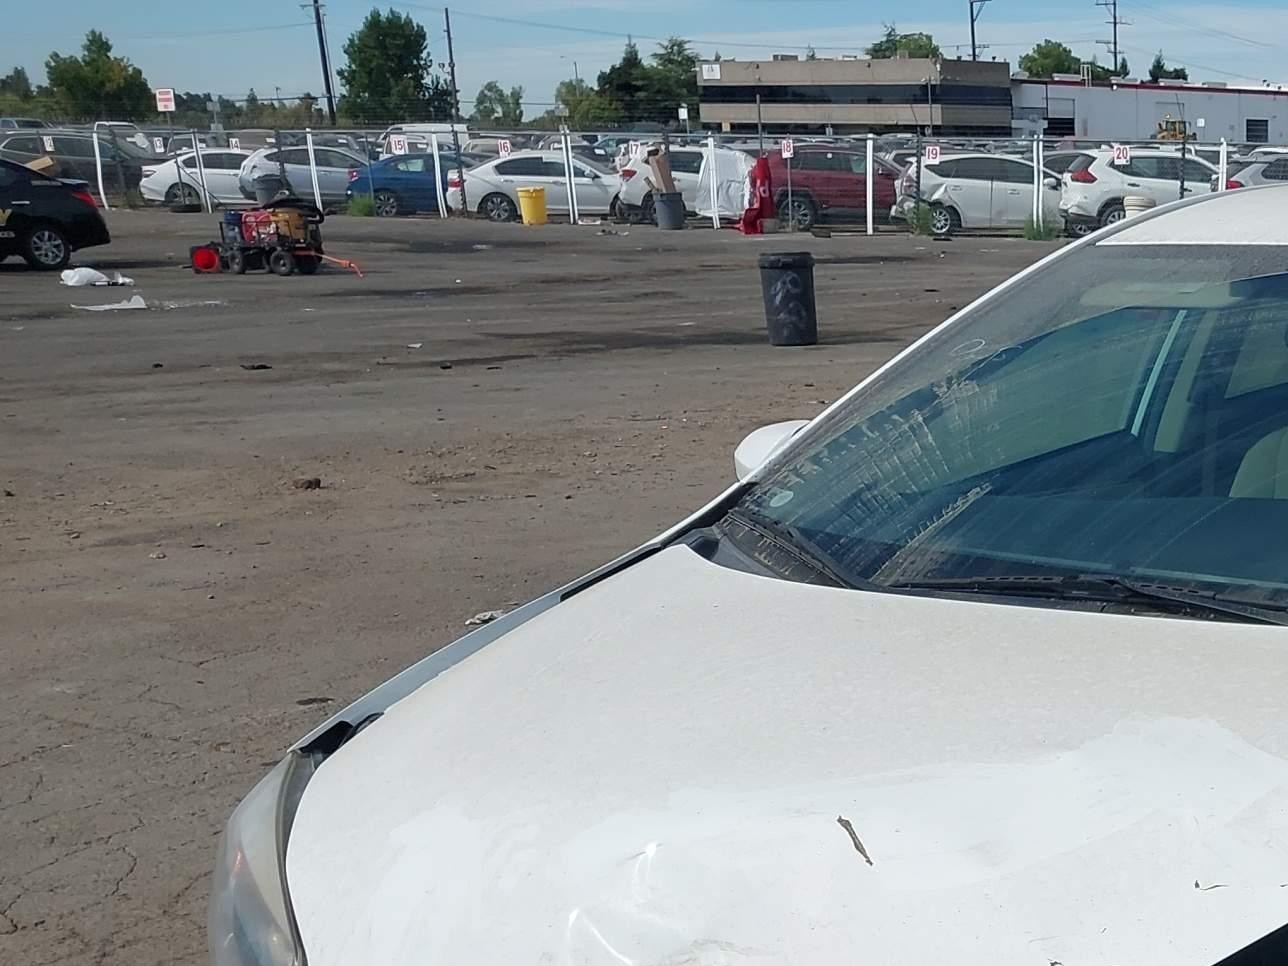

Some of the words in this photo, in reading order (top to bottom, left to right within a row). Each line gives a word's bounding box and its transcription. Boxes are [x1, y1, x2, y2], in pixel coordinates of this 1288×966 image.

[155, 139, 162, 149] 13
[230, 140, 239, 149] 14
[499, 141, 509, 152] 16
[630, 143, 639, 154] 17
[783, 142, 791, 153] 18
[927, 147, 937, 159] 19
[1115, 147, 1128, 159] 20
